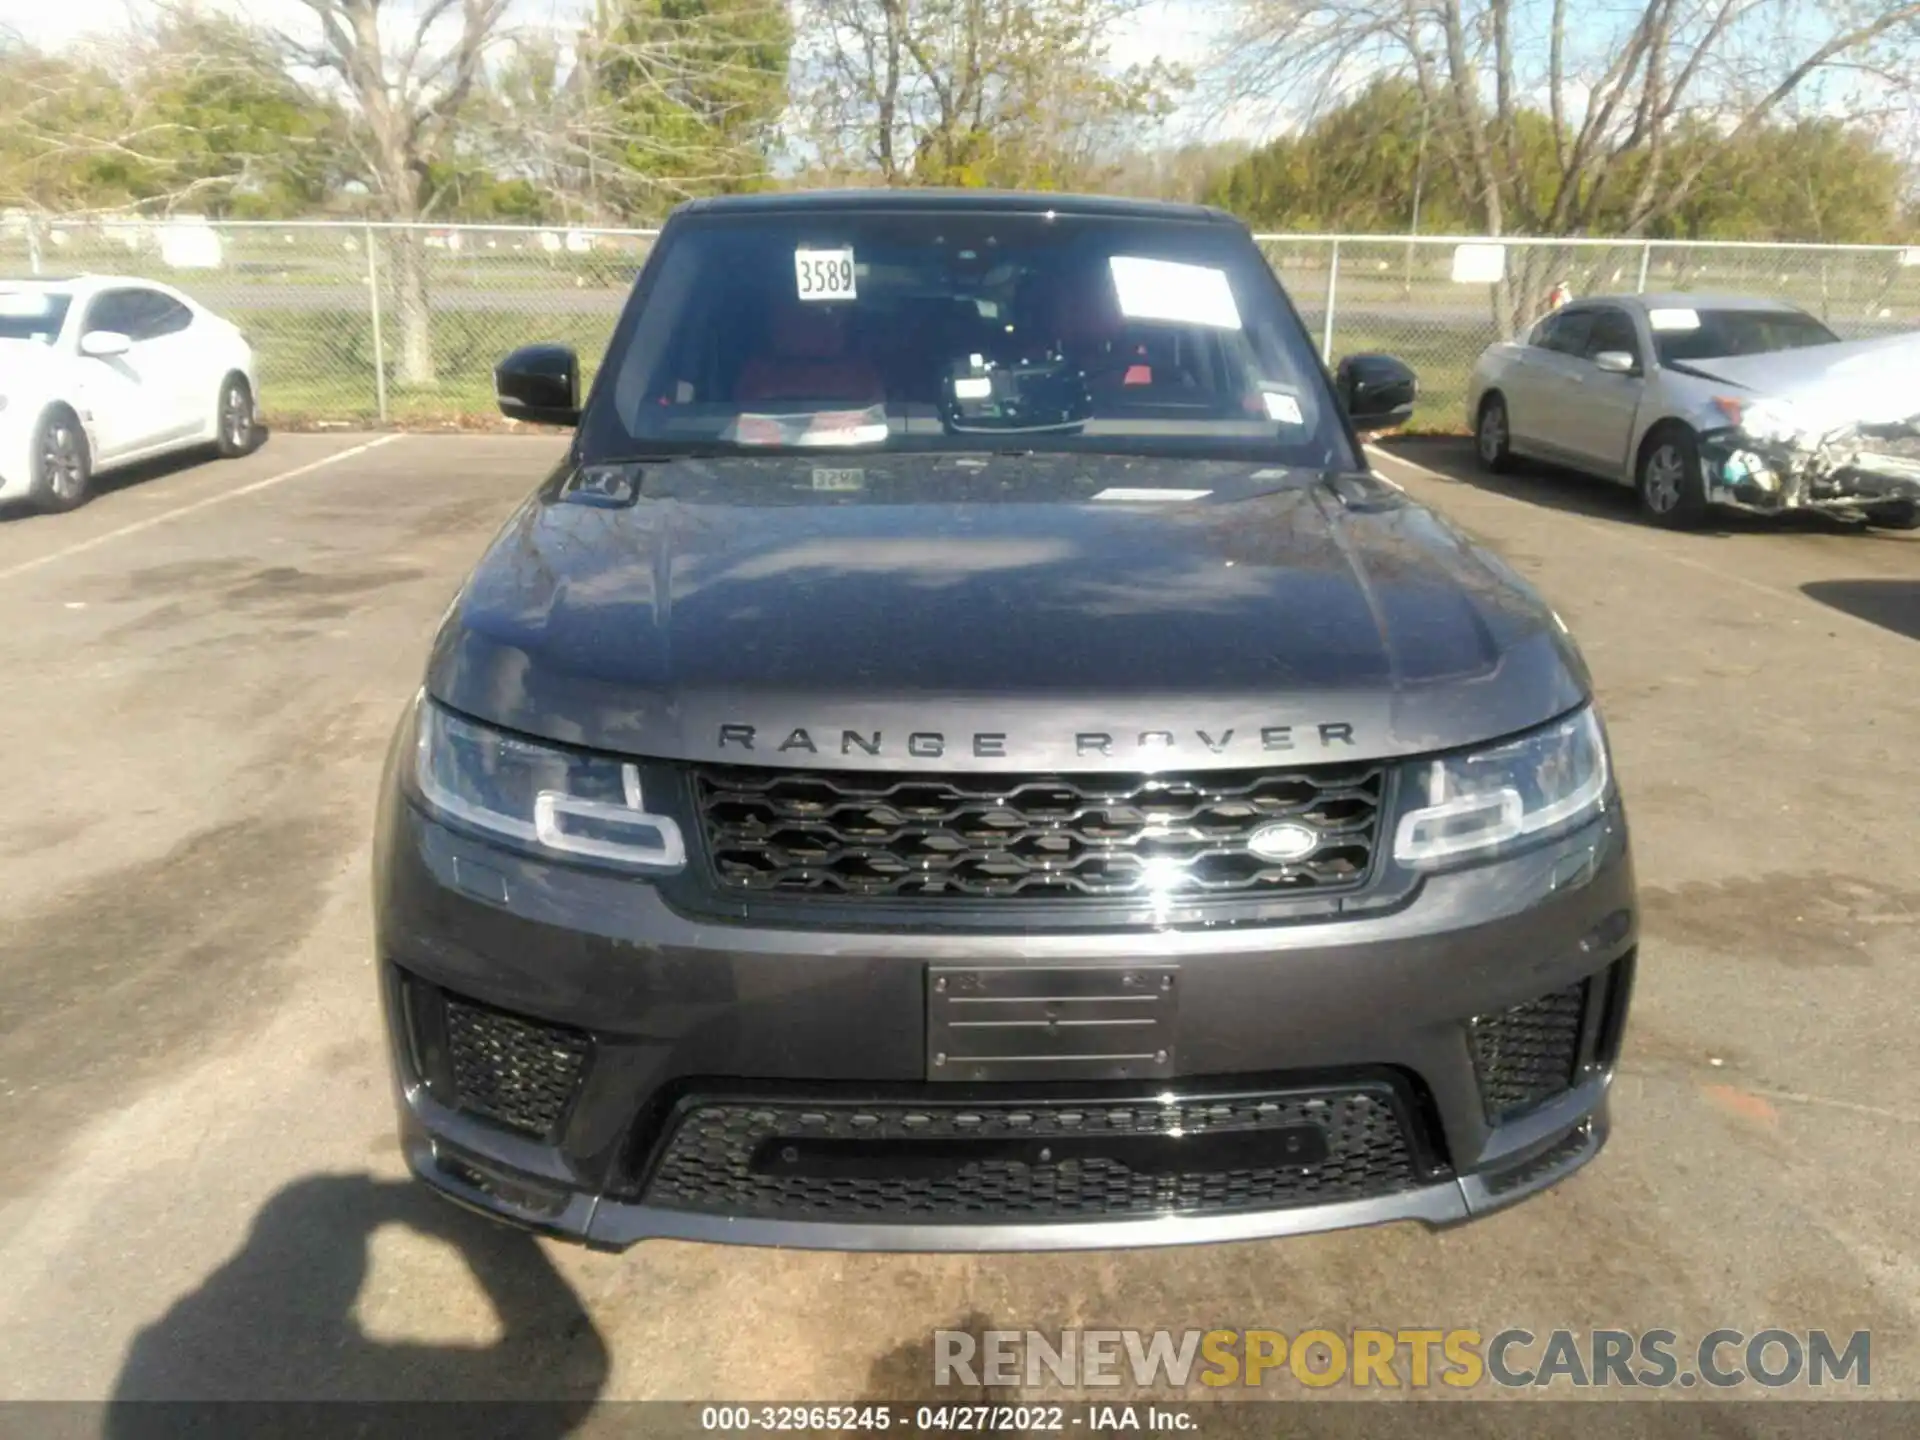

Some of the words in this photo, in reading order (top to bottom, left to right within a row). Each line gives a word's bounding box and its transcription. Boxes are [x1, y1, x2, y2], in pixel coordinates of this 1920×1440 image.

[800, 259, 852, 293] 3589
[717, 723, 1008, 758] RANGE
[1074, 722, 1356, 758] ROVER
